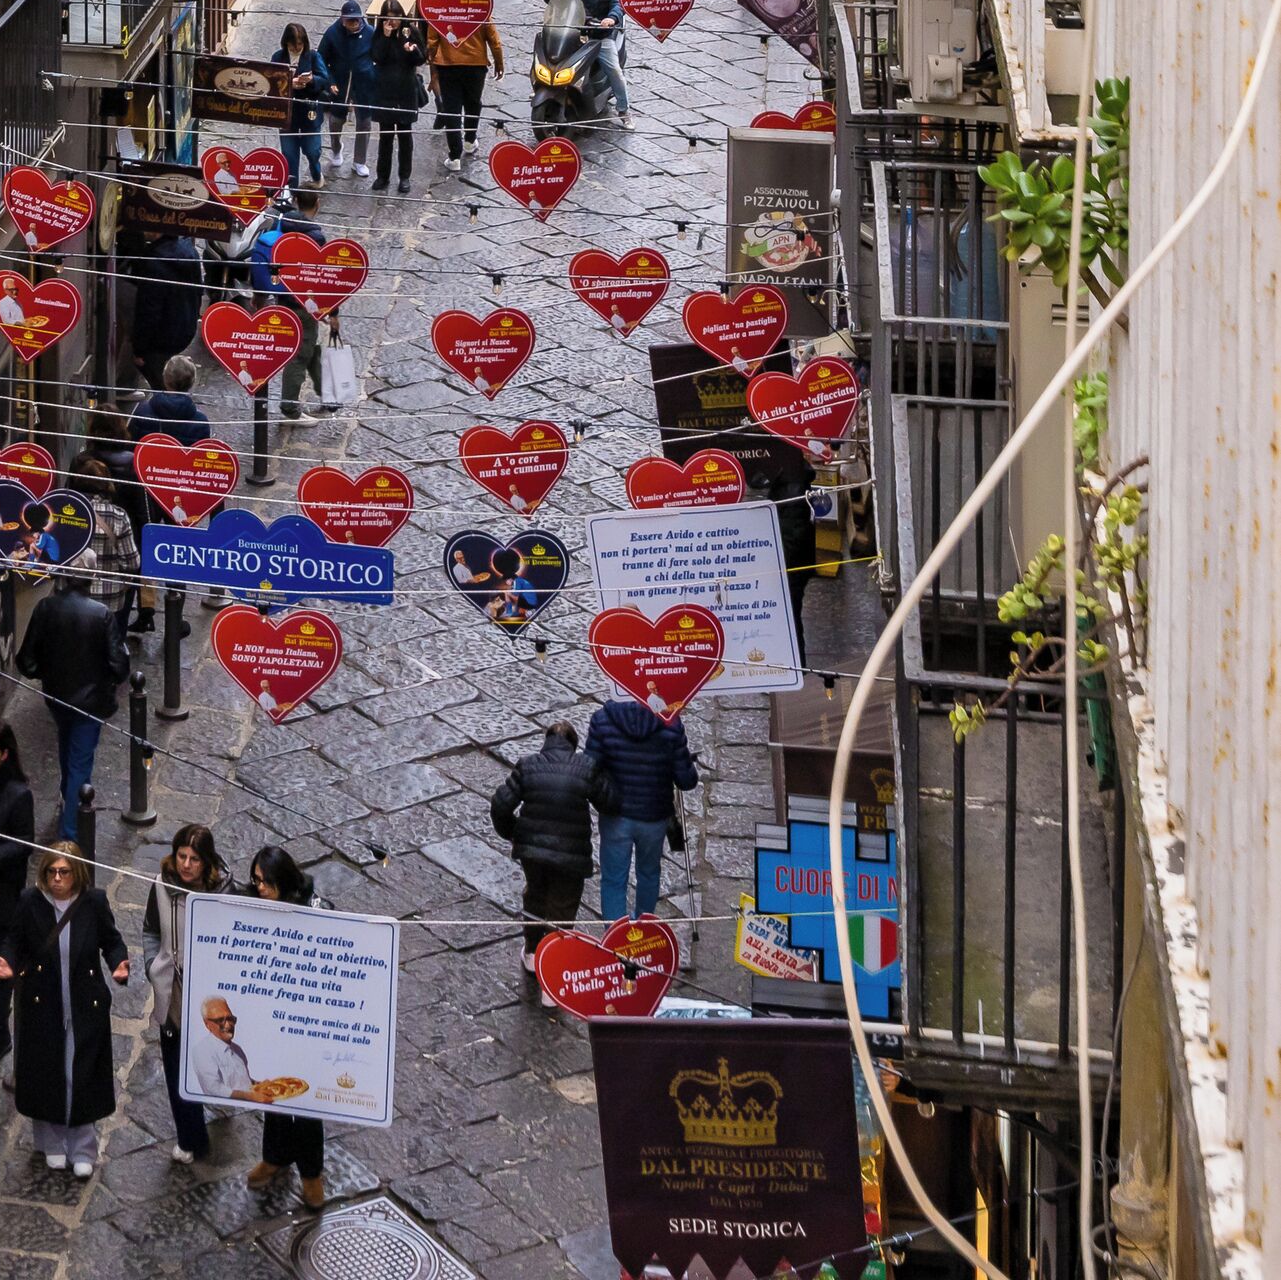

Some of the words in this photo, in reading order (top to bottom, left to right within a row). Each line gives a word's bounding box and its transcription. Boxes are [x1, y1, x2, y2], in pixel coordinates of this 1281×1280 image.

[244, 164, 274, 172] NAPOLI
[513, 167, 519, 175] E
[521, 166, 542, 175] figlie
[754, 187, 809, 197] ASSOCIAZIONE
[178, 214, 227, 232] Cappuccino
[773, 235, 790, 246] APN
[703, 324, 729, 335] pigliate
[746, 316, 777, 328] pastiglia
[231, 332, 275, 342] IPOCRISIA
[719, 332, 740, 341] siente
[748, 329, 765, 337] mme
[239, 343, 263, 351] l'acqua
[455, 340, 480, 348] Signori
[469, 347, 518, 355] Modestamente
[770, 406, 788, 417] vita
[493, 458, 502, 467] A
[518, 456, 539, 465] core
[479, 470, 497, 478] nun
[514, 463, 557, 474] cumanna
[630, 532, 663, 542] Essere
[665, 529, 694, 540] Avido
[705, 527, 740, 537] cattivo
[238, 539, 287, 553] Benvenuti
[289, 544, 299, 554] al
[600, 550, 619, 559] non
[622, 547, 630, 557] ti
[632, 545, 673, 556] portera'
[675, 544, 693, 552] mai
[696, 543, 708, 552] ad
[726, 538, 773, 550] obiettivo,
[154, 543, 261, 573] CENTRO
[268, 555, 384, 586] STORICO
[234, 644, 243, 652] Io
[244, 644, 264, 654] NON
[266, 648, 283, 656] sono
[285, 648, 319, 658] Italiana,
[231, 654, 256, 663] SONO
[258, 655, 324, 669] NAPOLETANA!
[635, 655, 654, 666] ogni
[252, 666, 261, 674] e'
[263, 668, 280, 676] nata
[281, 669, 302, 677] cosa!
[635, 667, 644, 676] e'
[645, 666, 688, 676] marenaro
[858, 874, 878, 901] DI
[232, 921, 269, 935] Essere
[271, 927, 304, 941] Avido
[307, 933, 313, 942] e
[316, 934, 355, 949] cattivo
[197, 933, 217, 944] non
[221, 936, 229, 945] ti
[231, 937, 277, 952] portera'
[280, 944, 300, 955] mai
[303, 948, 317, 958] ad
[320, 951, 333, 961] un
[336, 952, 388, 970] obiettivo,
[218, 951, 254, 963] tranne
[256, 954, 267, 965] di
[269, 957, 292, 969] fare
[295, 962, 317, 973] solo
[320, 964, 337, 976] del
[340, 969, 367, 980] male
[240, 969, 247, 978] a
[250, 968, 267, 981] chi
[270, 972, 297, 985] della
[300, 977, 318, 990] tua
[321, 980, 342, 992] vita
[217, 981, 238, 992] non
[240, 983, 274, 998] gliene
[275, 989, 305, 1002] frega
[308, 994, 321, 1004] un
[325, 998, 356, 1010] cazzo
[272, 1010, 285, 1020] Sii
[287, 1013, 319, 1027] sempre
[322, 1018, 349, 1030] amico
[351, 1021, 361, 1031] di
[363, 1024, 380, 1034] Dio
[288, 1026, 305, 1035] non
[307, 1028, 330, 1039] sarai
[333, 1033, 349, 1043] mai
[352, 1035, 371, 1046] solo
[641, 1159, 685, 1176] DAL
[690, 1159, 827, 1180] PRESIDENTE
[669, 1218, 718, 1235] SEDE
[724, 1221, 807, 1239] STORICA
